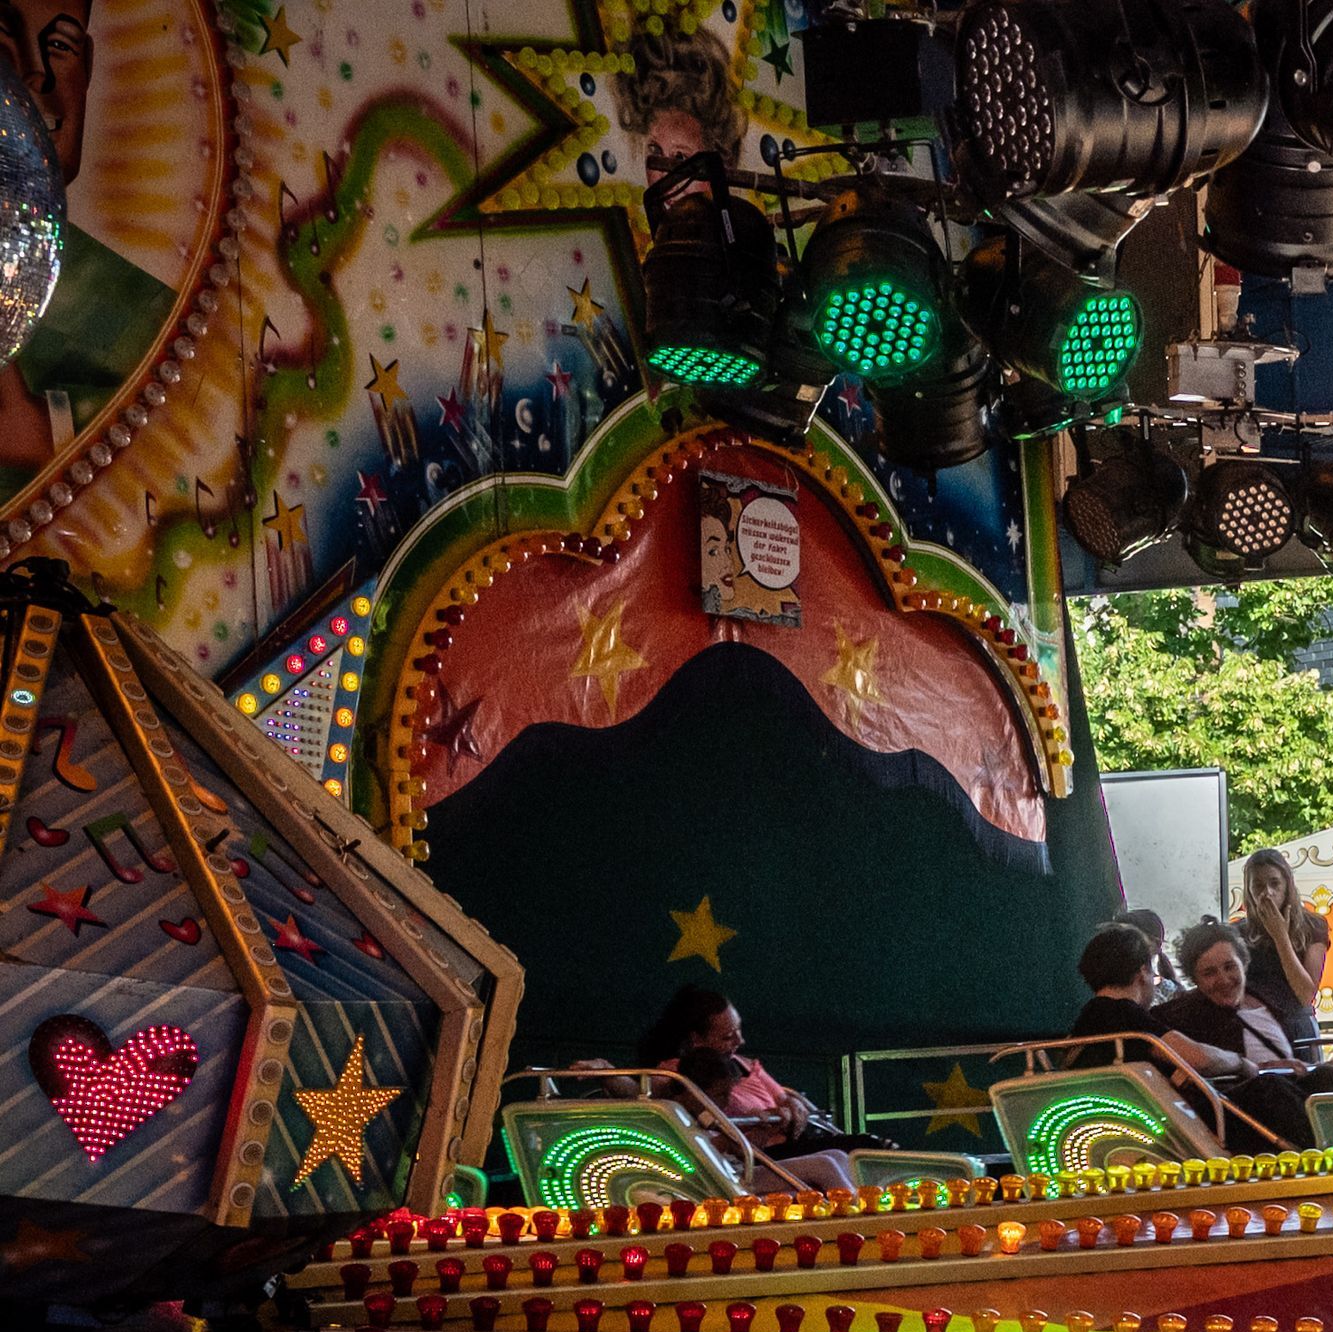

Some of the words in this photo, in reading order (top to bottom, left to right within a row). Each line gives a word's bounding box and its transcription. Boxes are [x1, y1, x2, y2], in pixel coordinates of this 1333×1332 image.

[742, 528, 767, 539] müssen
[754, 541, 766, 550] der
[751, 553, 791, 567] geschlossen
